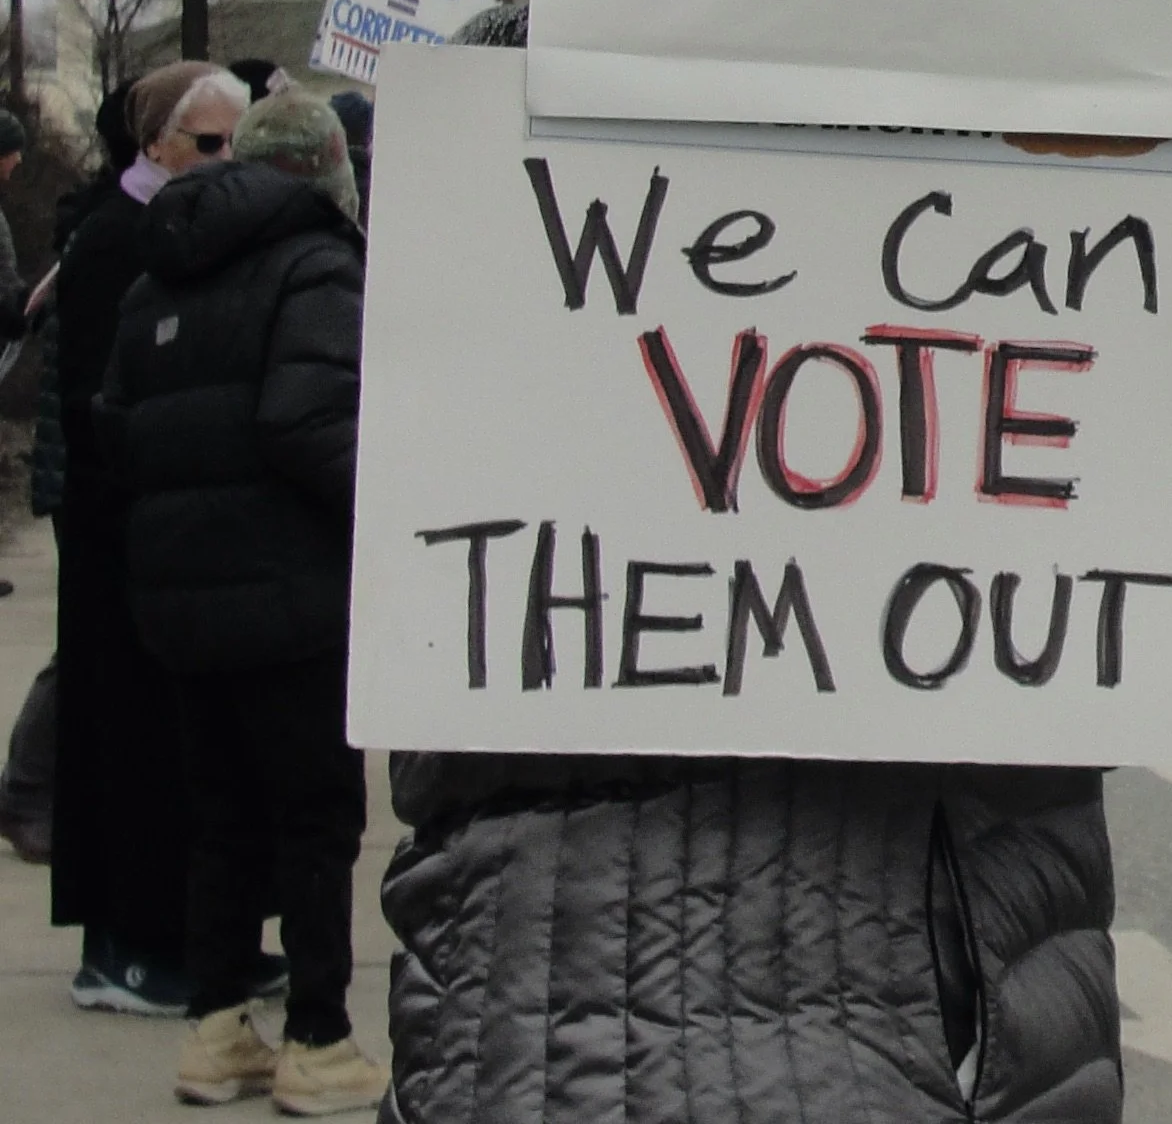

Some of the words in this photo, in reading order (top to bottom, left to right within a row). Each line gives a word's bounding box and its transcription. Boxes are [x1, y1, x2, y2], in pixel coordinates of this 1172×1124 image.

[524, 157, 797, 315] We
[882, 190, 1159, 315] Can
[637, 324, 1098, 513] VOTE
[415, 519, 837, 696] THEM
